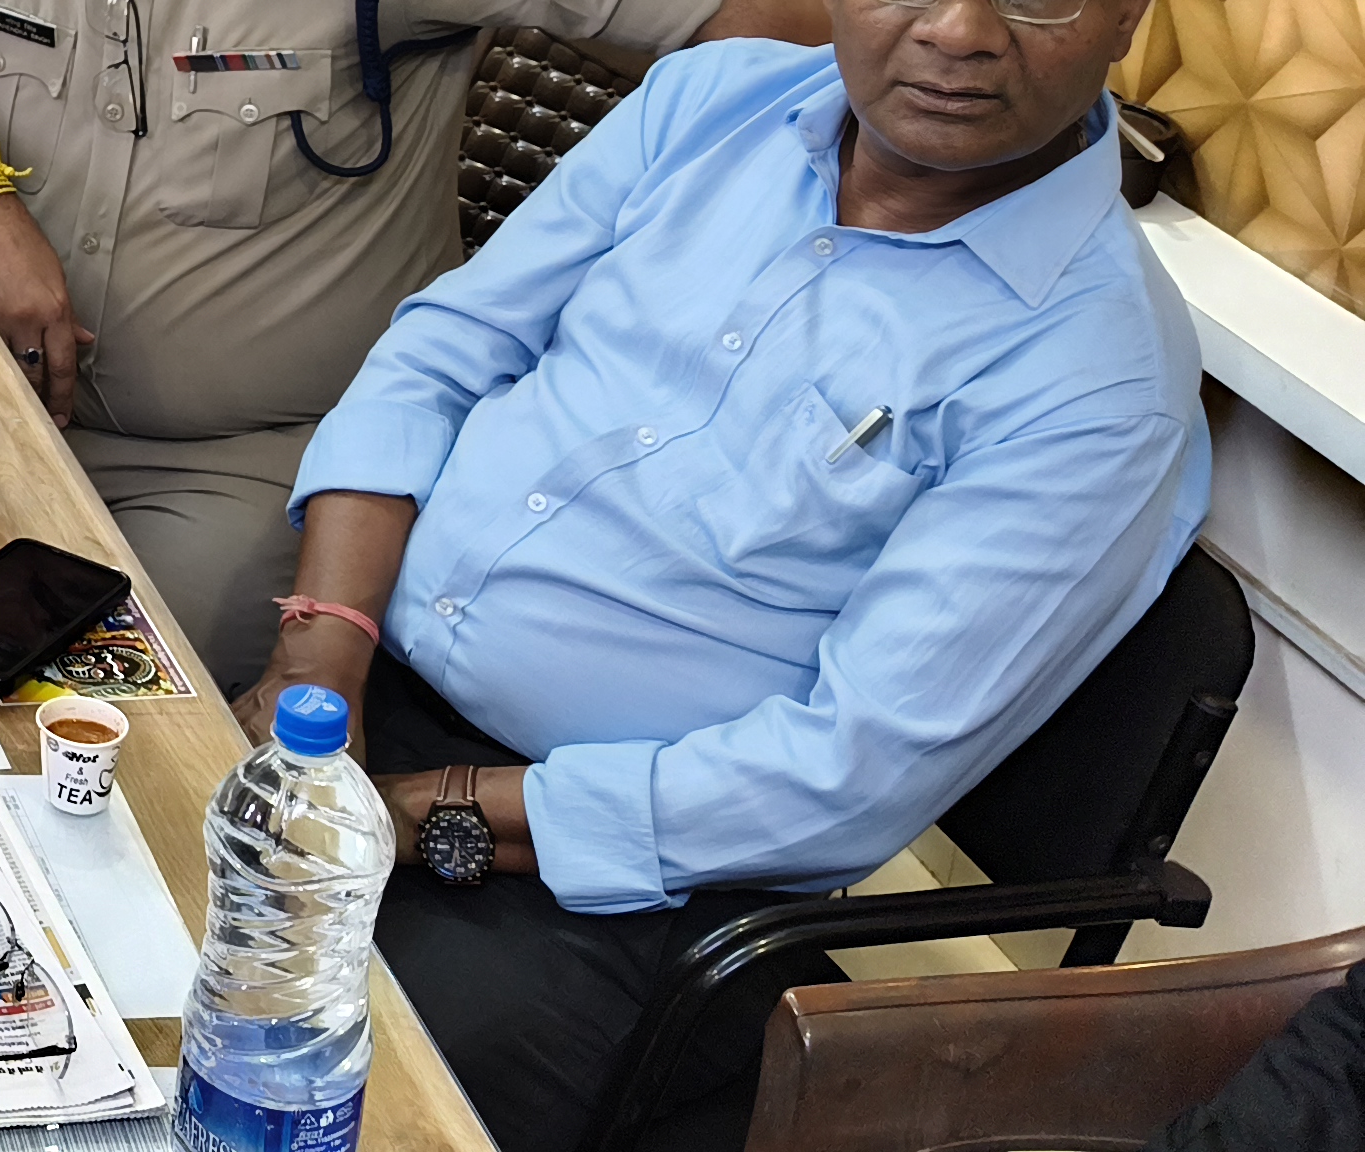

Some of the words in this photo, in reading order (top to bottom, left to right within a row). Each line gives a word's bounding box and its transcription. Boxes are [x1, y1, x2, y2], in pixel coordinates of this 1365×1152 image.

[77, 767, 84, 776] &
[65, 773, 89, 786] Fresh
[57, 782, 93, 805] TEA
